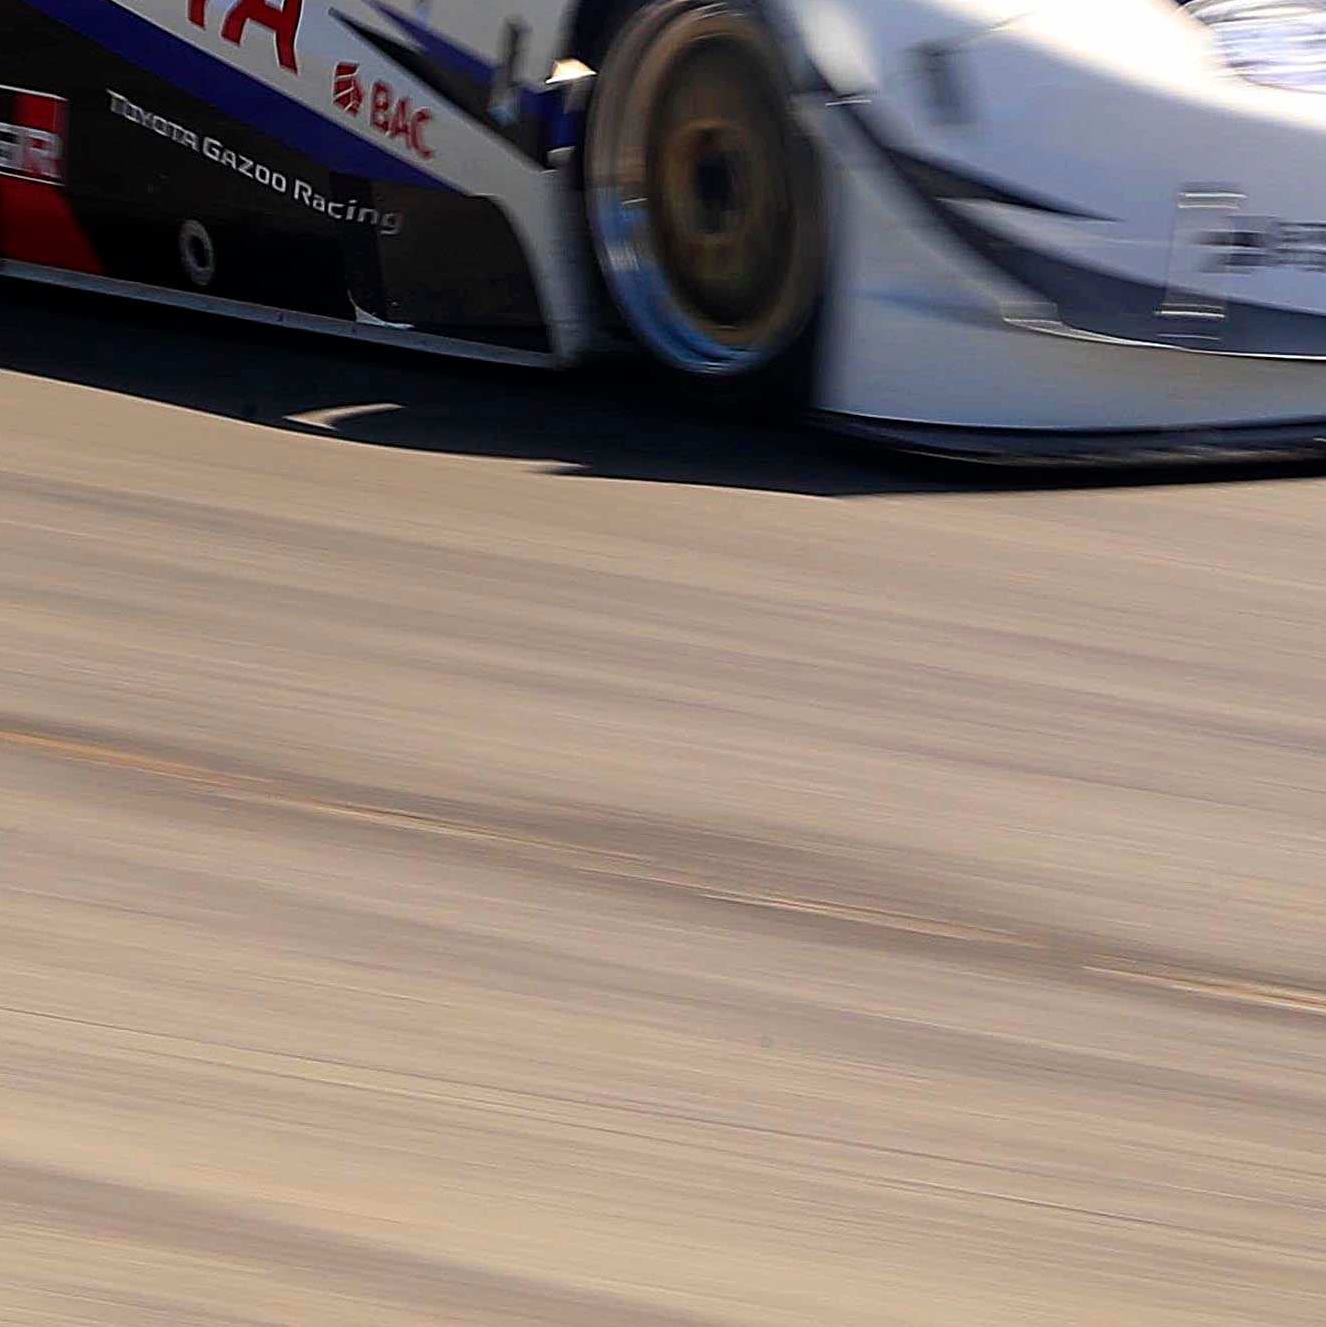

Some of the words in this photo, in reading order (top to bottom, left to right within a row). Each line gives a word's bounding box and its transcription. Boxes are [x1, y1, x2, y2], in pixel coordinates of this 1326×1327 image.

[106, 88, 199, 152] TOYOTA
[202, 135, 287, 194] GAZOO
[293, 179, 405, 236] Racing
[370, 79, 435, 160] BAC
